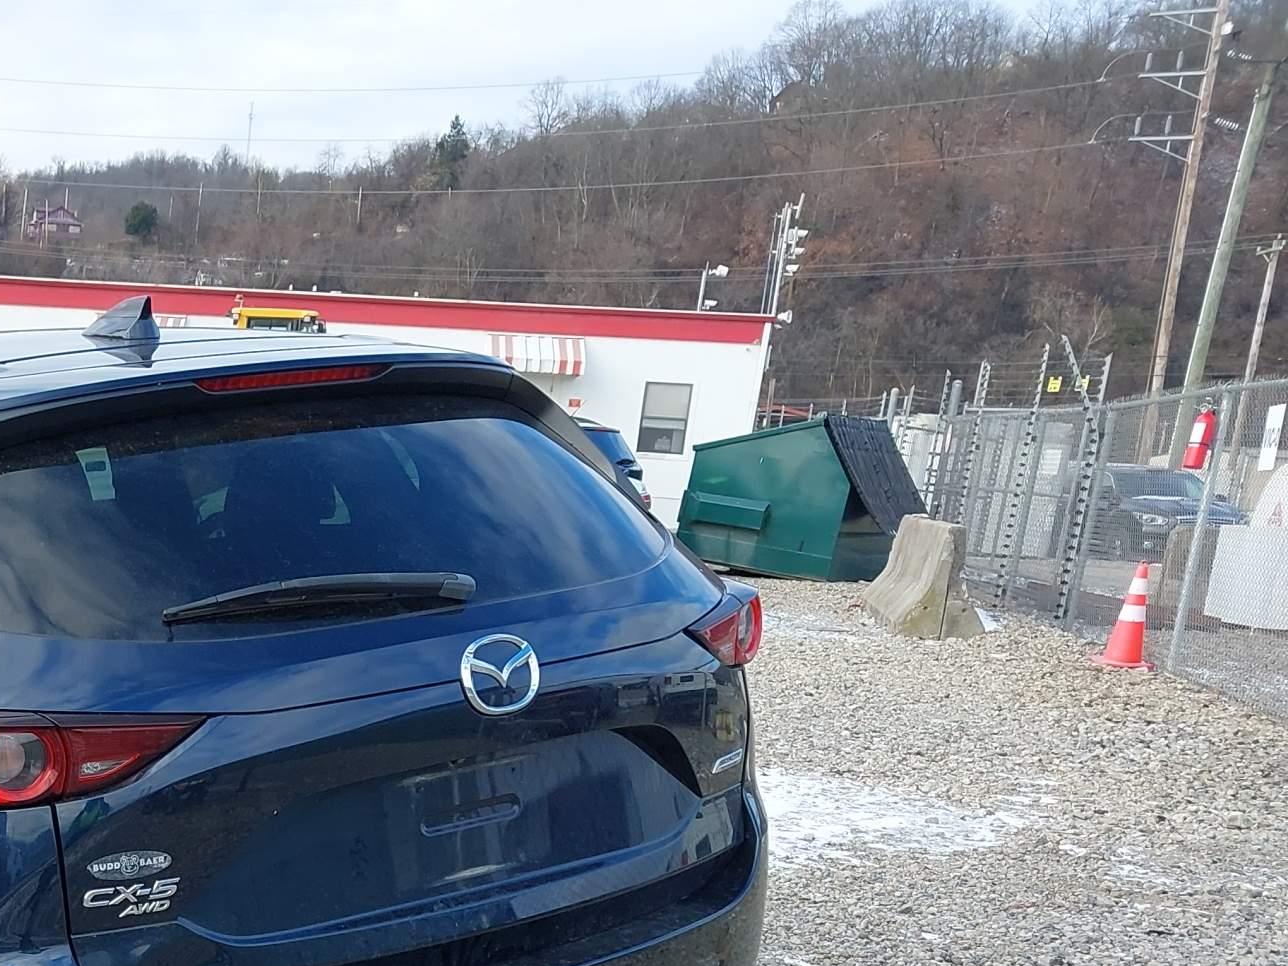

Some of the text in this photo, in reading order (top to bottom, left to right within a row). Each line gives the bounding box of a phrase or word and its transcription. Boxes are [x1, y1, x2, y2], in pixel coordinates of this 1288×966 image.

[92, 862, 121, 873] BUDD
[139, 856, 165, 867] BAER
[83, 877, 181, 907] CX-5
[119, 900, 171, 917] AWD
